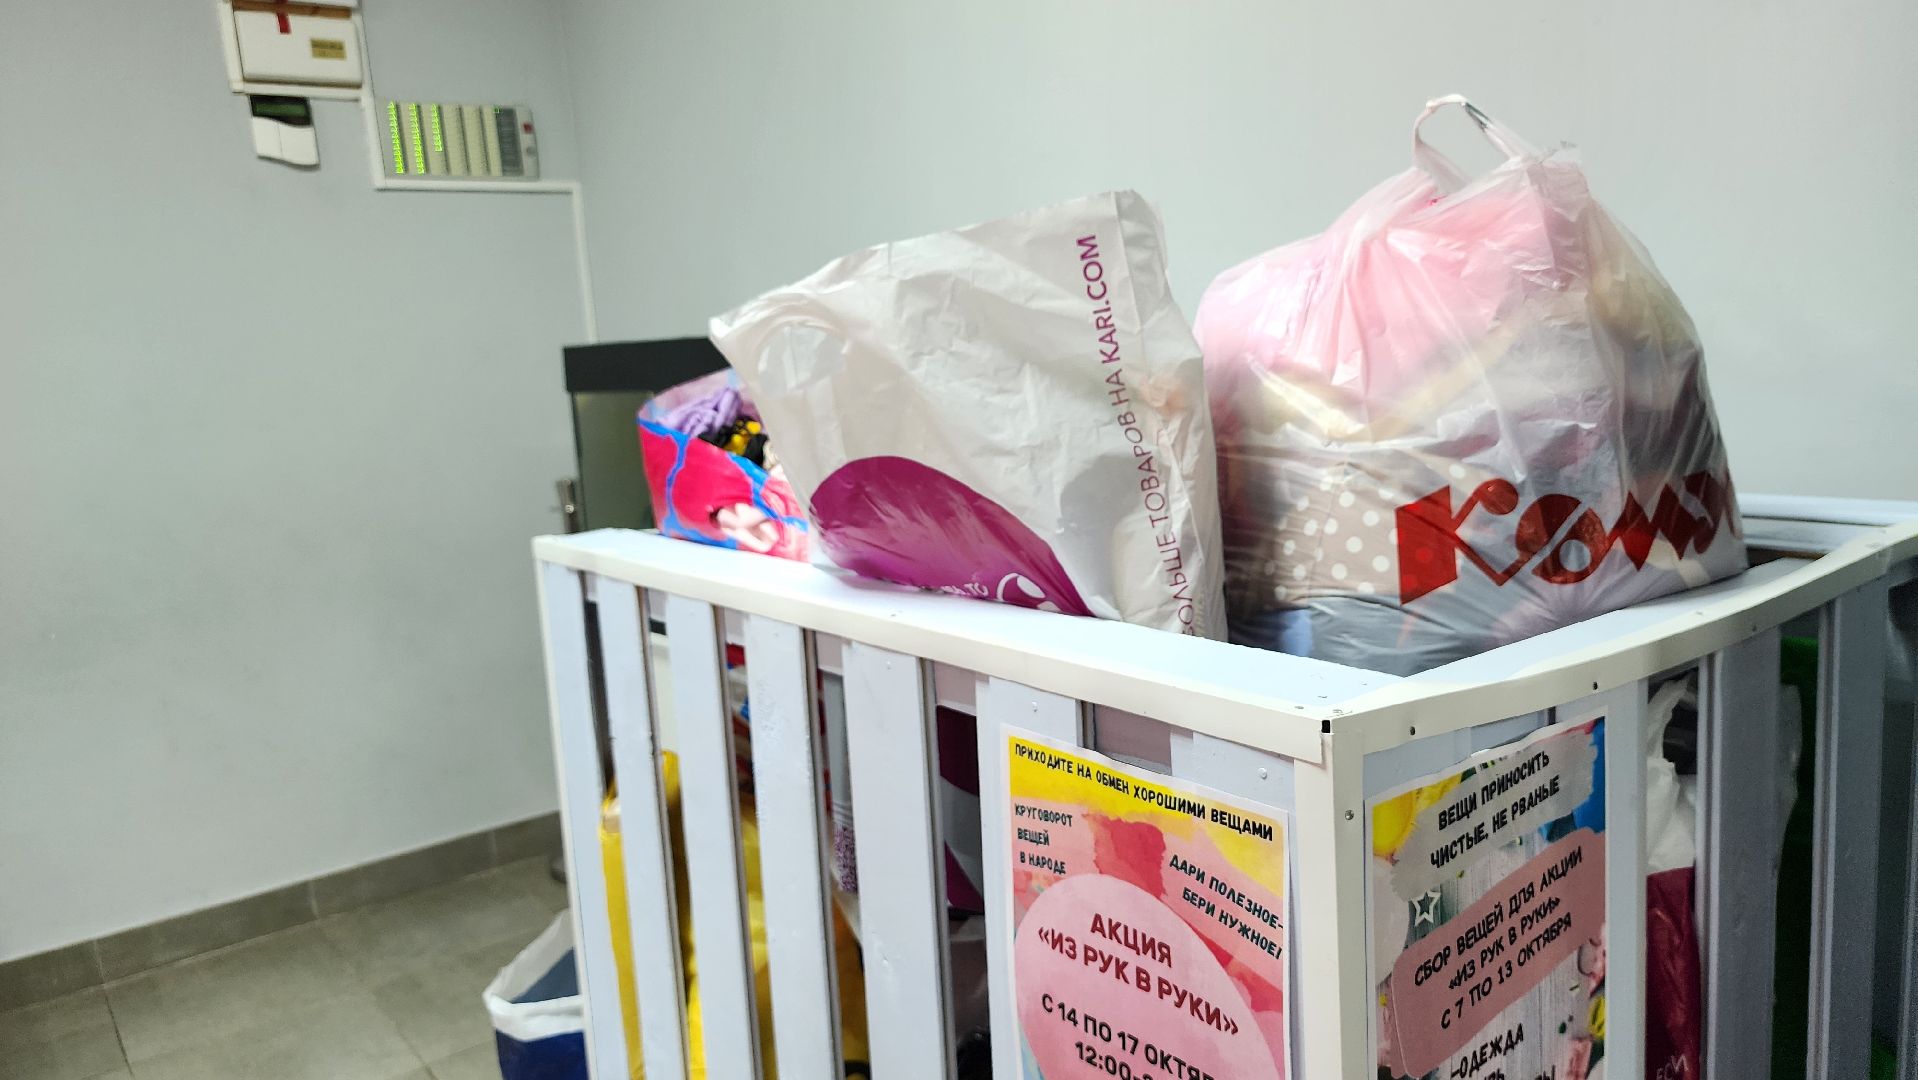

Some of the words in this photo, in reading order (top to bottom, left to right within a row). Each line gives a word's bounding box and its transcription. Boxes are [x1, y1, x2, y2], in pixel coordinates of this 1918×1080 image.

[1076, 235, 1120, 364] KARI.COM
[1106, 369, 1130, 406] НА
[1118, 411, 1168, 528] ТОВАРОВ
[1015, 743, 1073, 774] ПРИХОДИТЕ
[1077, 764, 1092, 781] НА
[1096, 770, 1129, 795] ОБМЕН
[1133, 785, 1205, 820] ХОРОШИМИ
[1211, 808, 1272, 842] ВЕЩАМИ
[1015, 803, 1073, 827] КРУГОВОРОТ
[1430, 822, 1489, 868] ЧИСТЫЕ,
[1492, 808, 1507, 833] НЕ
[1511, 775, 1560, 821] РВАНЫЕ
[1438, 792, 1477, 831] ВЕЩИ
[1481, 751, 1550, 806] ПРИНОСИТЬ
[1017, 827, 1049, 846] ВЕЩЕЙ
[1020, 851, 1026, 864] В
[1028, 853, 1066, 875] НАРОДЕ
[1169, 854, 1206, 884] ДАРИ
[1090, 913, 1172, 968] АКЦИЯ
[1183, 887, 1215, 917] БЕРИ
[1218, 909, 1283, 960] НУЖНОЕ!
[1414, 945, 1451, 986] СБОР
[1457, 902, 1503, 955] ВЕЩЕЙ
[1509, 882, 1535, 918] ДЛЯ
[1540, 846, 1582, 892] АКЦИИ
[1449, 959, 1476, 990] «ИЗ
[1480, 936, 1504, 968] РУК
[1508, 926, 1517, 945] В
[1521, 897, 1560, 935] РУКИ»
[1038, 927, 1077, 960] «ИЗ
[1084, 944, 1130, 984] РУК
[1135, 966, 1151, 993] В
[1157, 976, 1239, 1035] РУКИ»
[1441, 1008, 1450, 1029] С
[1455, 997, 1463, 1018] 7
[1469, 976, 1493, 1006] ПО
[1498, 960, 1513, 984] 13
[1517, 912, 1572, 966] ОКТЯБРЯ
[1042, 993, 1053, 1013] С
[1057, 1002, 1078, 1028] 14
[1084, 1014, 1112, 1042] ПО
[1117, 1031, 1139, 1055] 17
